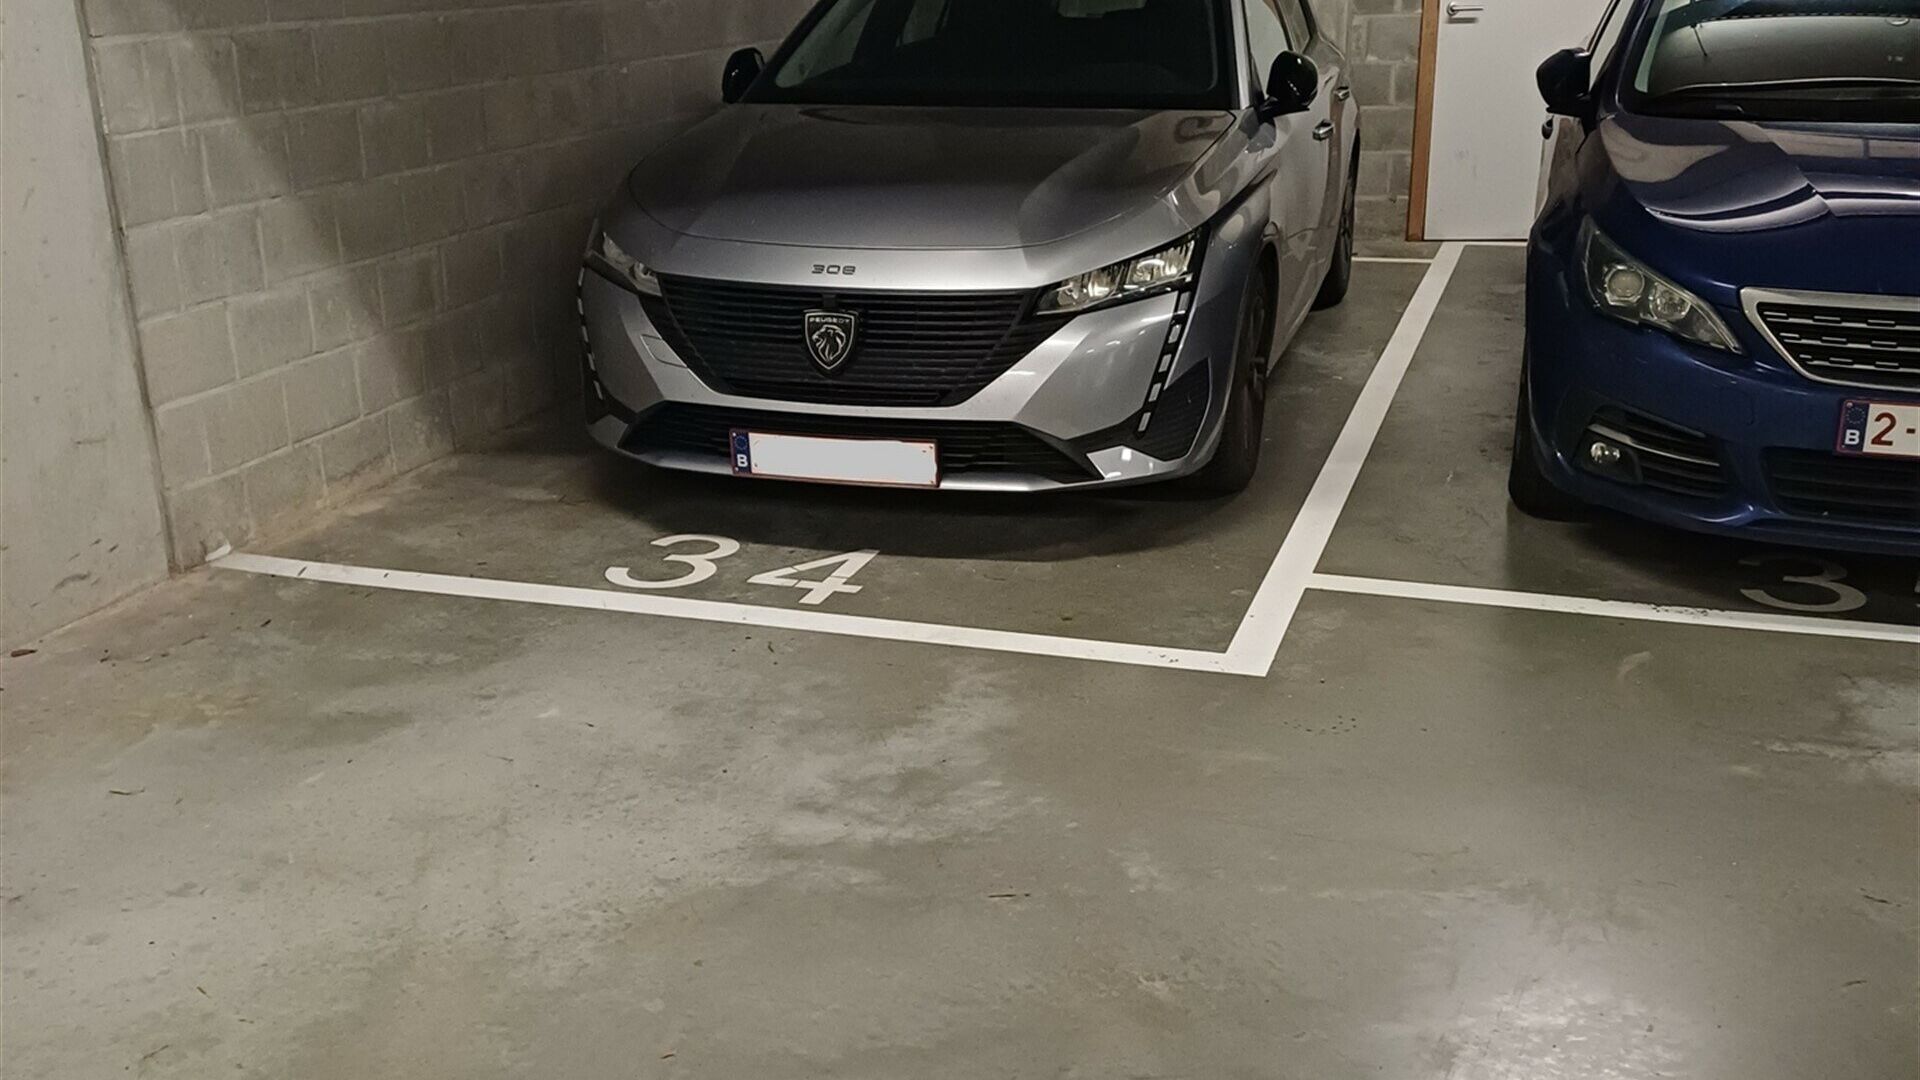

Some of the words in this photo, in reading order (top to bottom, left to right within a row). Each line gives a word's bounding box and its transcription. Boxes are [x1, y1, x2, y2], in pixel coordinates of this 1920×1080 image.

[811, 264, 856, 275] 308
[1844, 429, 1860, 445] B
[737, 454, 748, 467] B
[604, 535, 880, 605] 34
[1737, 556, 1920, 612] 3
